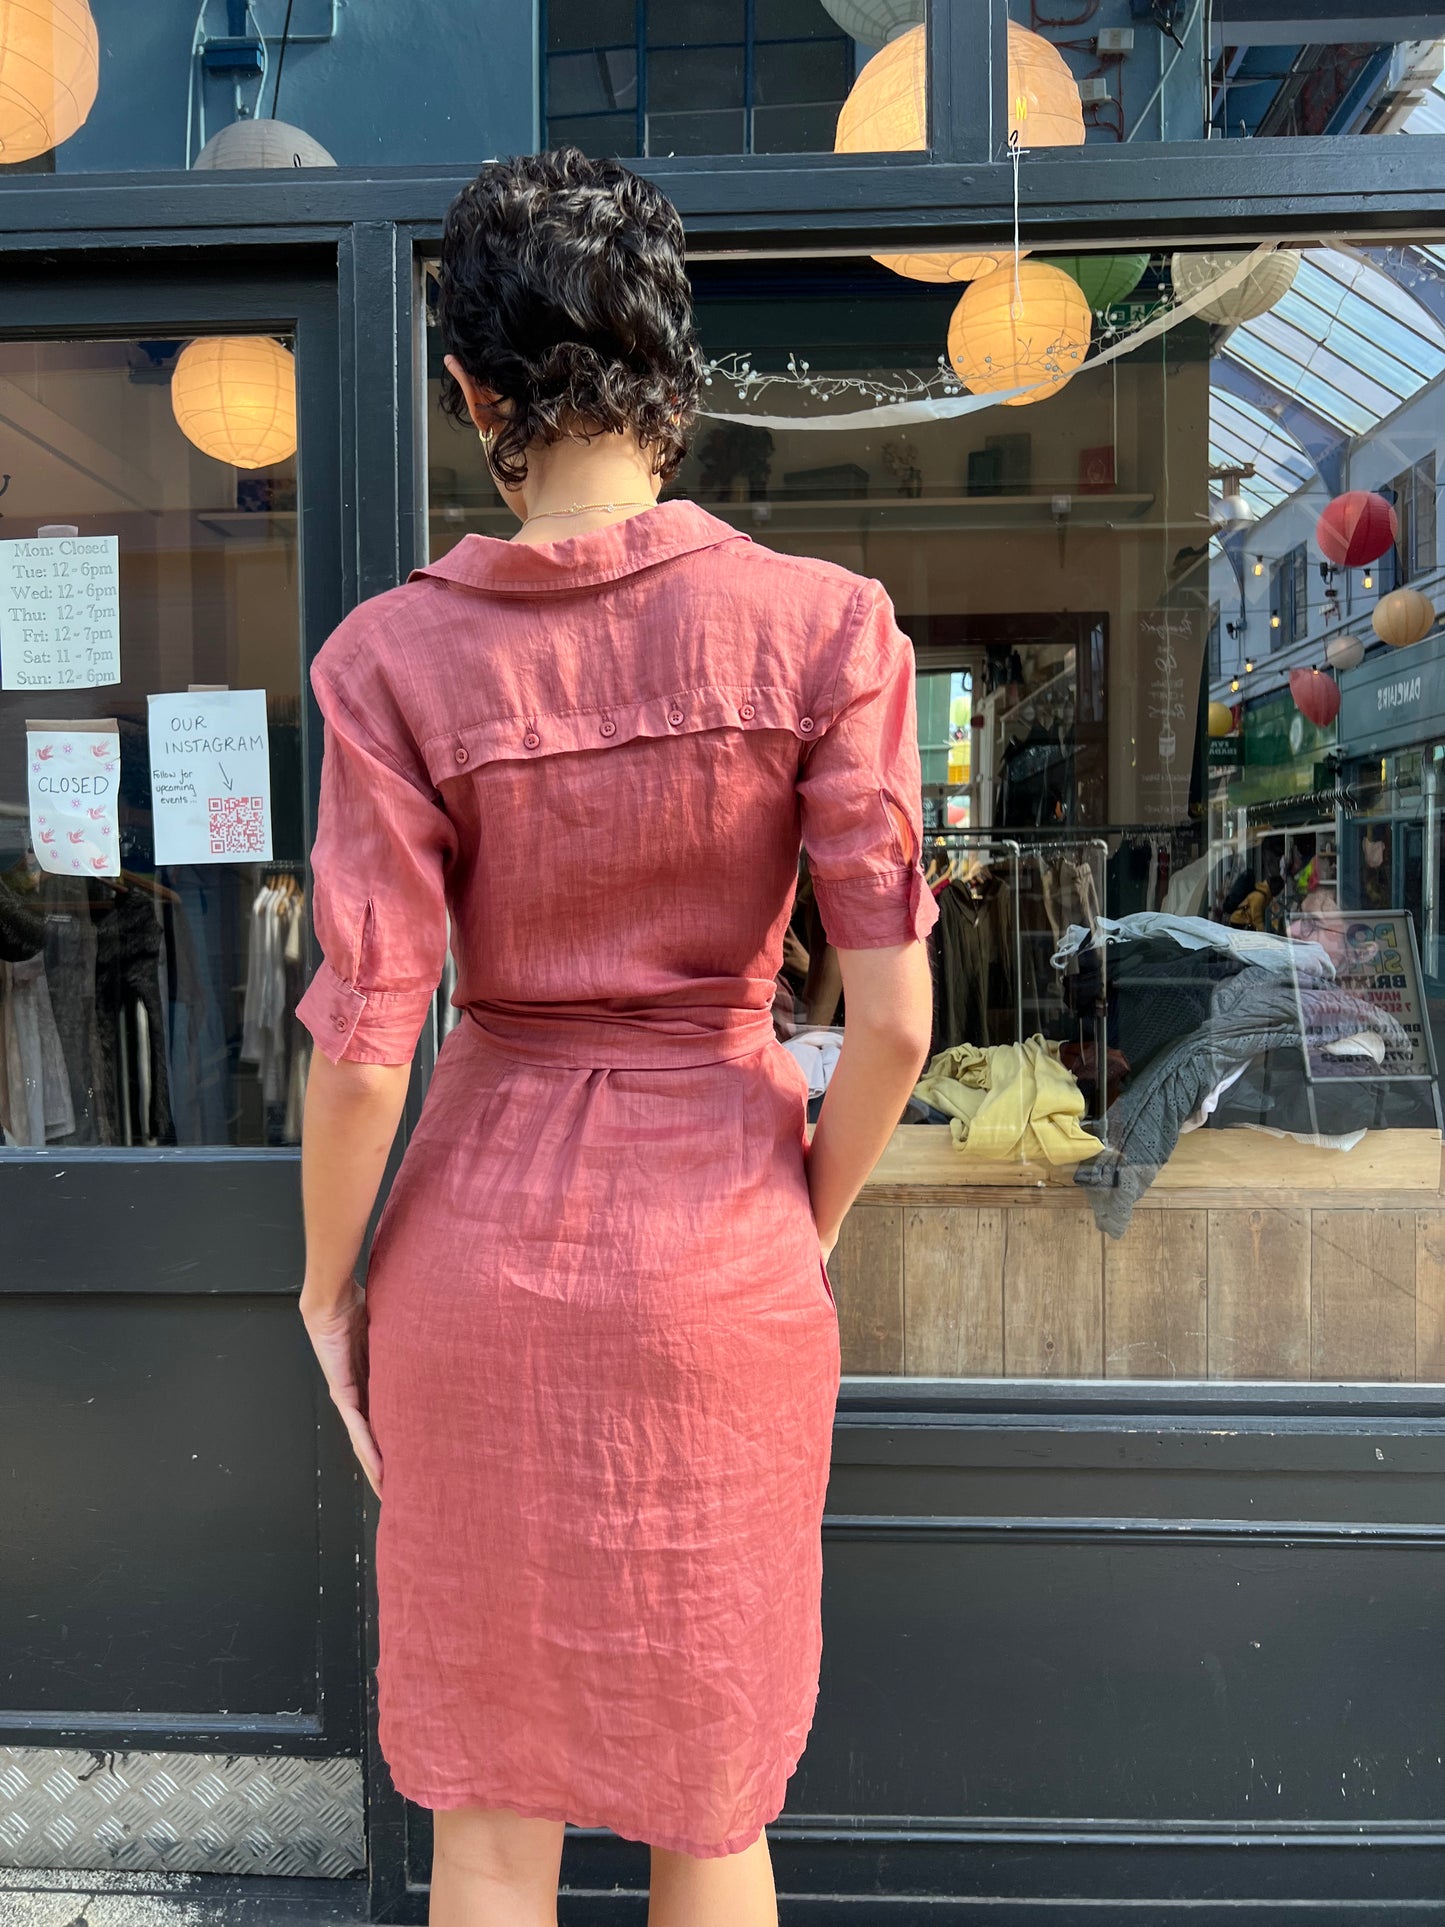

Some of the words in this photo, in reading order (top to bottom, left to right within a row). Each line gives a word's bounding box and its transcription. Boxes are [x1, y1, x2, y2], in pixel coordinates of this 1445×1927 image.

[14, 543, 54, 557] Mon:
[59, 539, 109, 556] Closed
[12, 564, 47, 578] Tue:
[10, 585, 53, 600] Wed:
[8, 607, 47, 622] Thu:
[22, 628, 49, 642] Fri:
[23, 649, 51, 664] Sat:
[17, 670, 51, 685] Sun:
[171, 715, 207, 731] OUR
[165, 735, 264, 754] INSTAGRAM
[153, 769, 176, 779] Follow
[179, 769, 193, 785] for
[38, 776, 109, 796] CLOSED
[155, 784, 197, 797] upcoming
